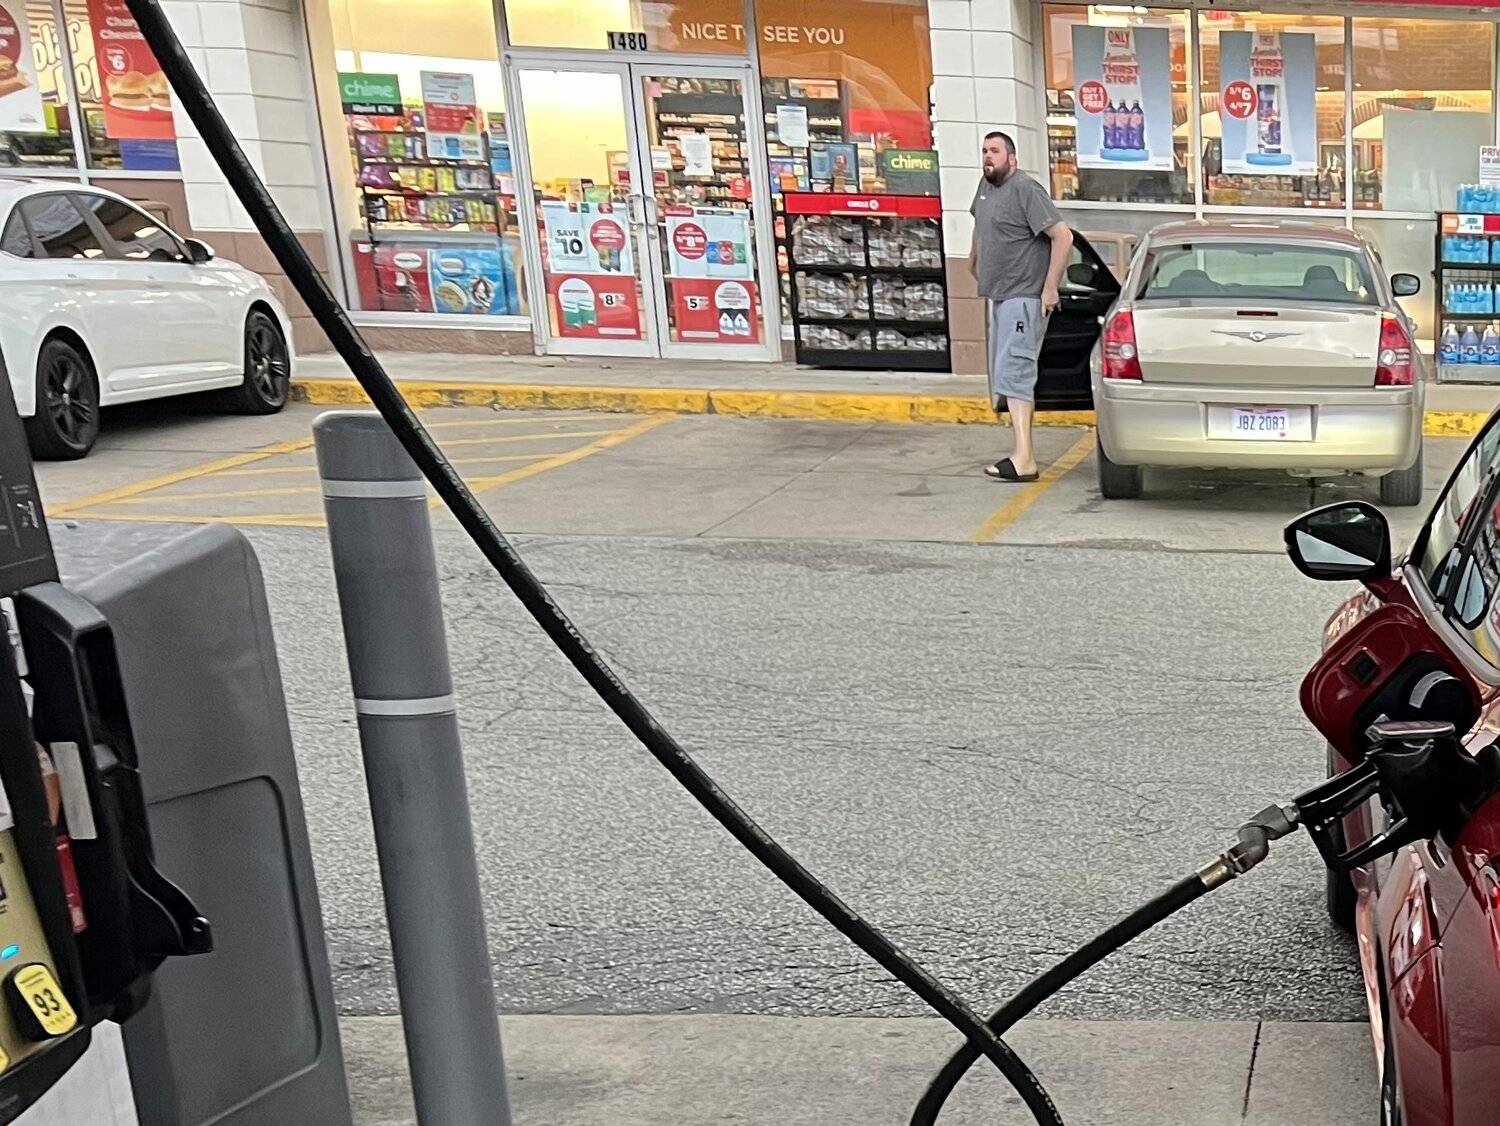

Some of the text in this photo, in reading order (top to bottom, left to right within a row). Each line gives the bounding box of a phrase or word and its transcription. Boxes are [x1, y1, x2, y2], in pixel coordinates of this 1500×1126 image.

[682, 22, 728, 40] NICE
[763, 25, 800, 43] SEE
[803, 27, 844, 44] YOU
[609, 32, 647, 51] 1480
[1102, 63, 1139, 74] THIRST
[344, 81, 394, 98] chime
[890, 155, 931, 170] chime
[556, 229, 580, 238] SAVE
[1258, 415, 1285, 431] 2083
[33, 988, 61, 1017] 93
